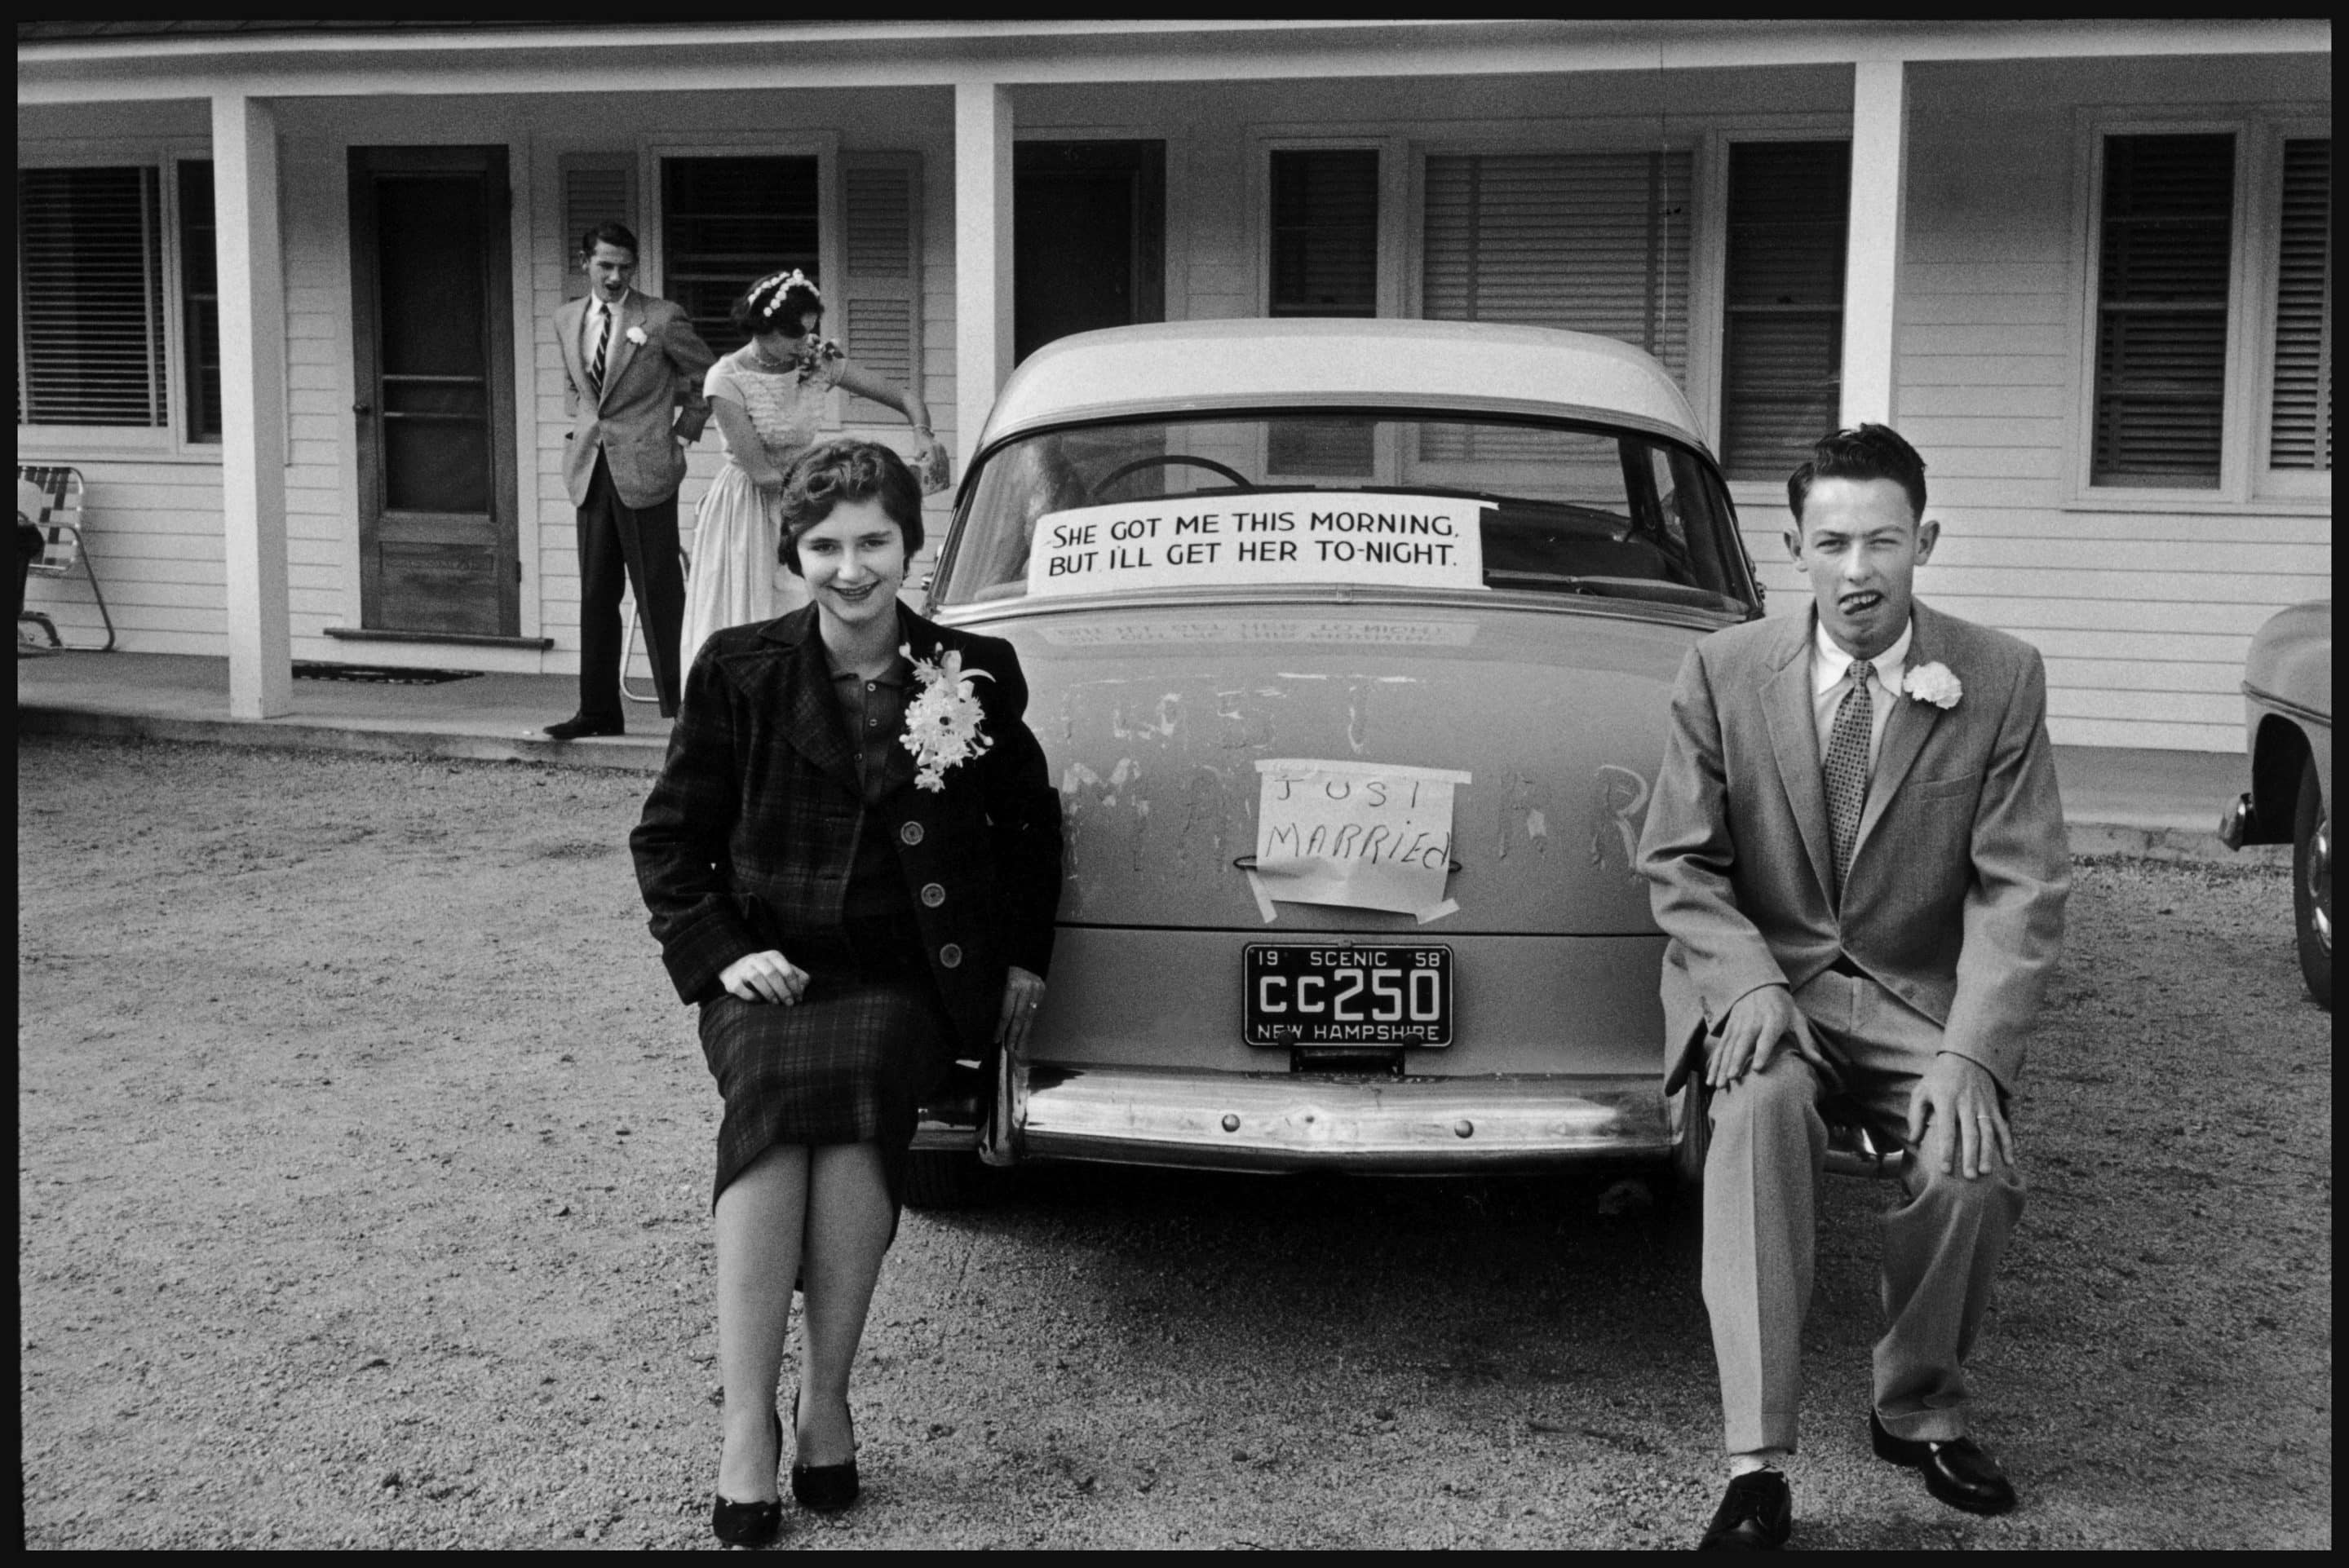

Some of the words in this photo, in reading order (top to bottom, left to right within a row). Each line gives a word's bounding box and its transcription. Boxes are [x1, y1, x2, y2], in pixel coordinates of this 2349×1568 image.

[1052, 524, 1097, 549] SHE
[1110, 518, 1161, 541] GOT
[1175, 515, 1219, 535] ME
[1232, 512, 1294, 532] THIS
[1049, 552, 1099, 576] BUT
[1166, 542, 1221, 565] GET
[1238, 541, 1297, 562] HER
[1259, 951, 1278, 966] 19
[1310, 952, 1387, 967] SCENIC
[1415, 952, 1440, 967] 58
[1259, 969, 1440, 1021] CC250
